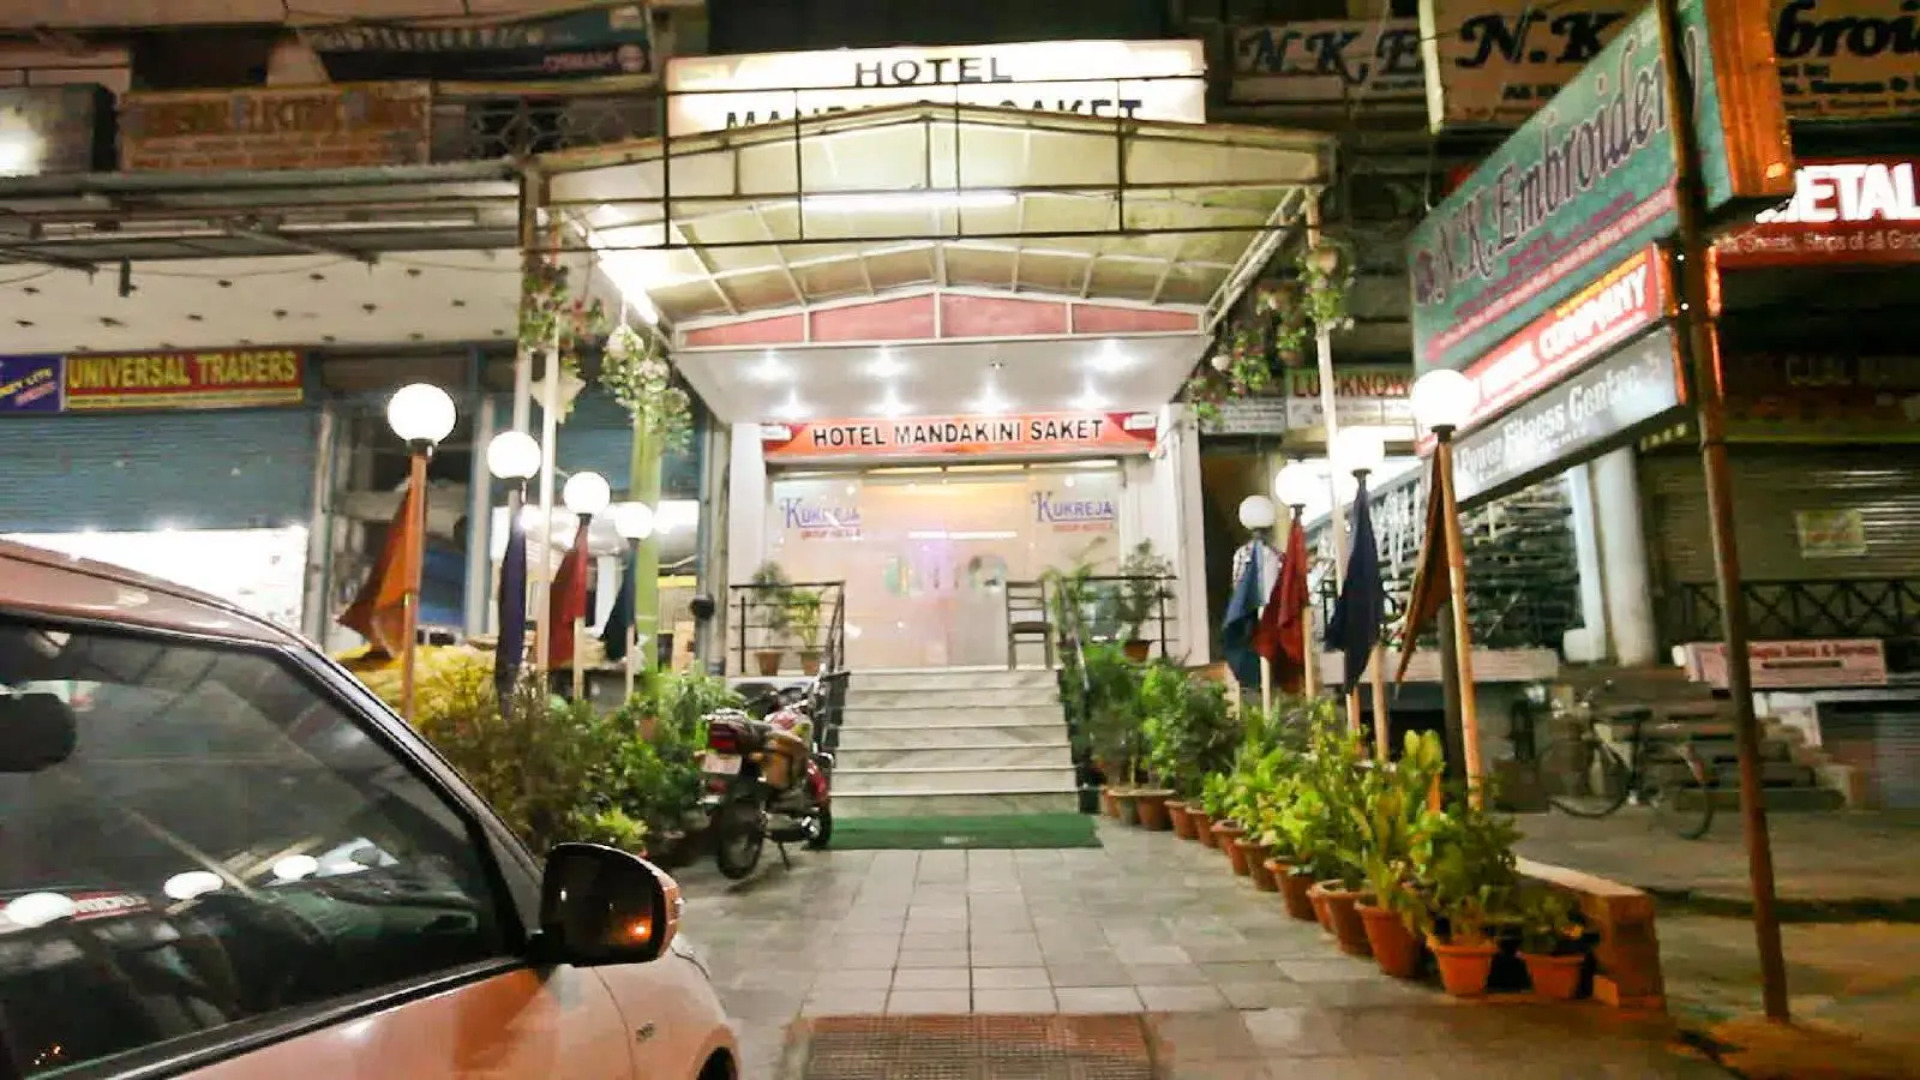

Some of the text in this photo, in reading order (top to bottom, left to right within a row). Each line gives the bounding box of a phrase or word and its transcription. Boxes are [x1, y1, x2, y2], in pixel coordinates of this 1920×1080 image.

[855, 57, 1013, 88] HOTEL
[67, 355, 192, 389] UNIVERSAL
[195, 350, 299, 384] TRADERS
[813, 425, 886, 446] HOTEL
[893, 421, 1022, 445] MANDAKINI
[1030, 418, 1104, 442] SAKET
[1031, 490, 1114, 522] KUKREJA
